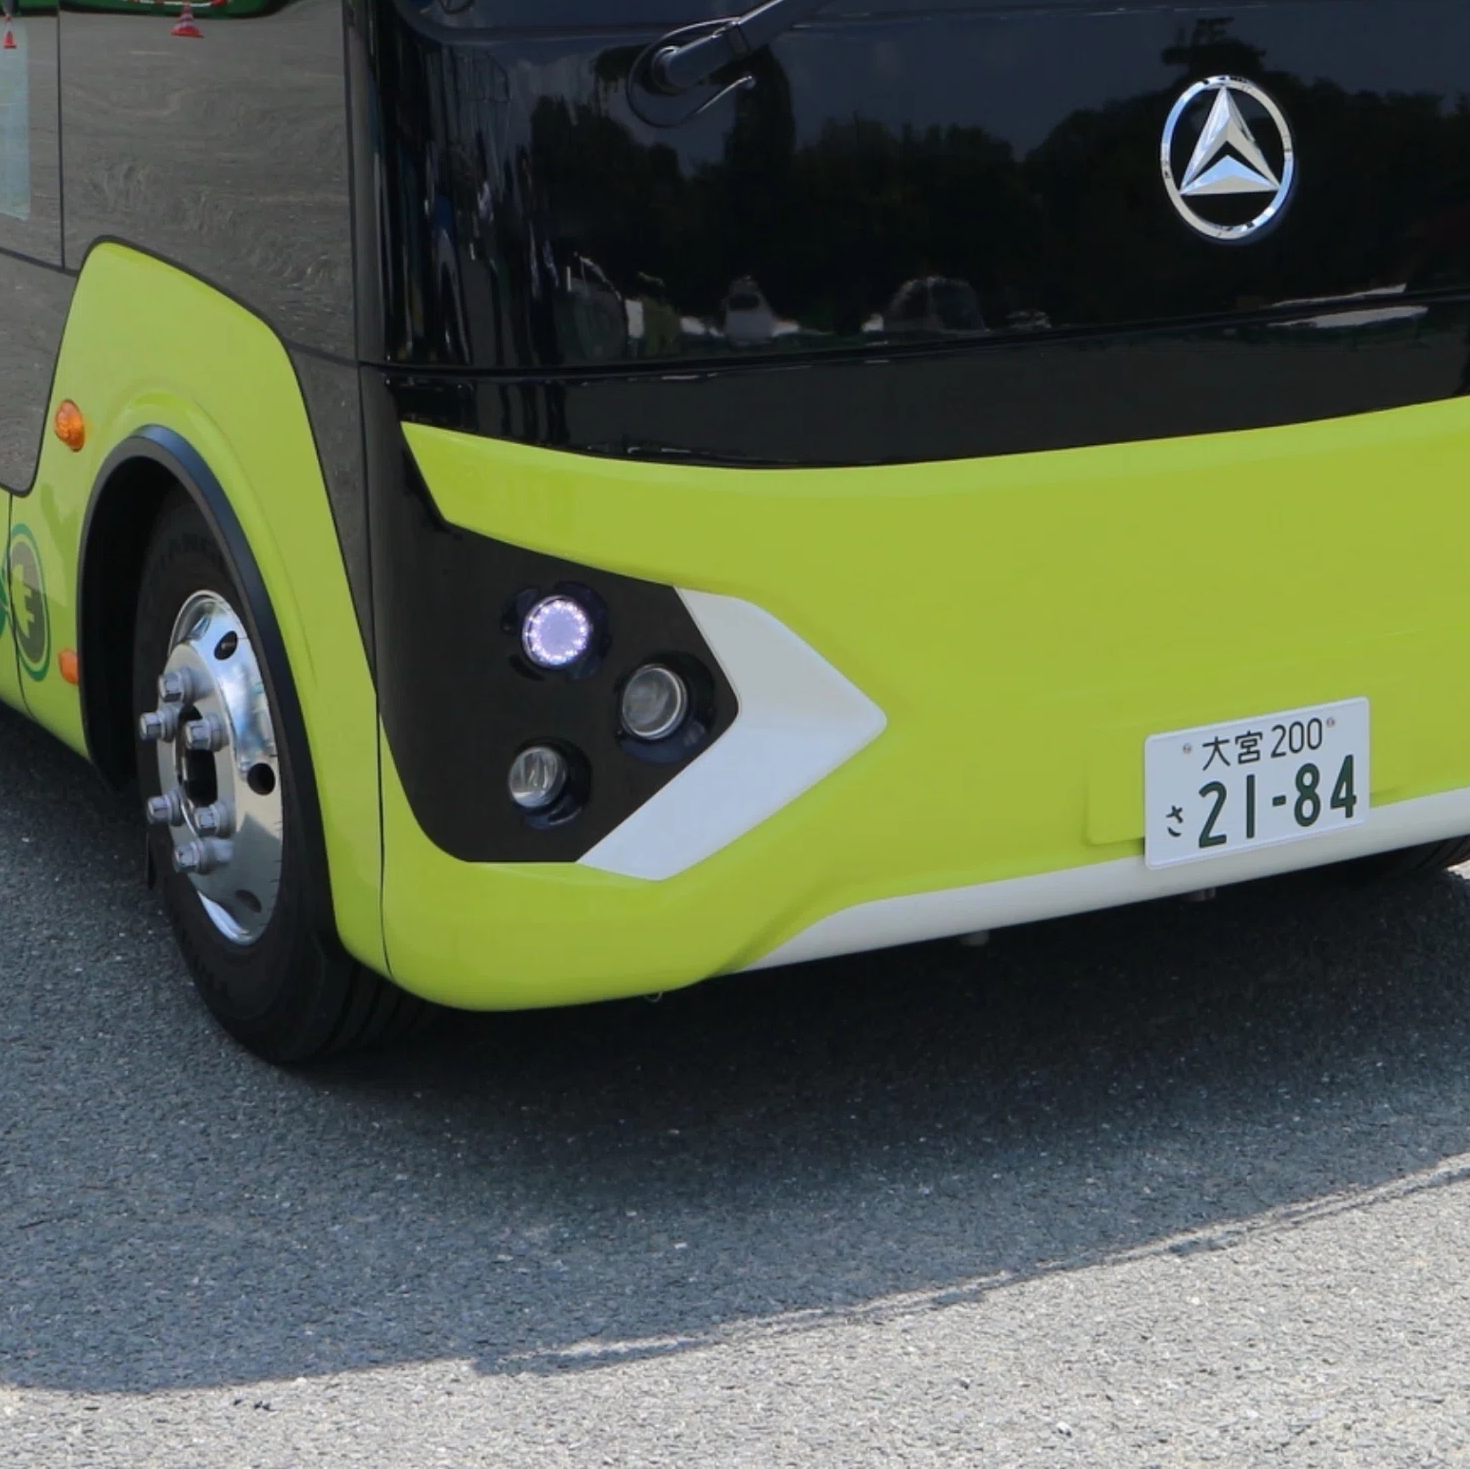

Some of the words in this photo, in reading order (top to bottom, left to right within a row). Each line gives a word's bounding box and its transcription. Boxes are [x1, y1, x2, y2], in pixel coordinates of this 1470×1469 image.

[1202, 730, 1263, 771] 大宮
[1270, 717, 1323, 759] 200
[1165, 805, 1184, 838] さ
[1198, 754, 1358, 849] 21-84
